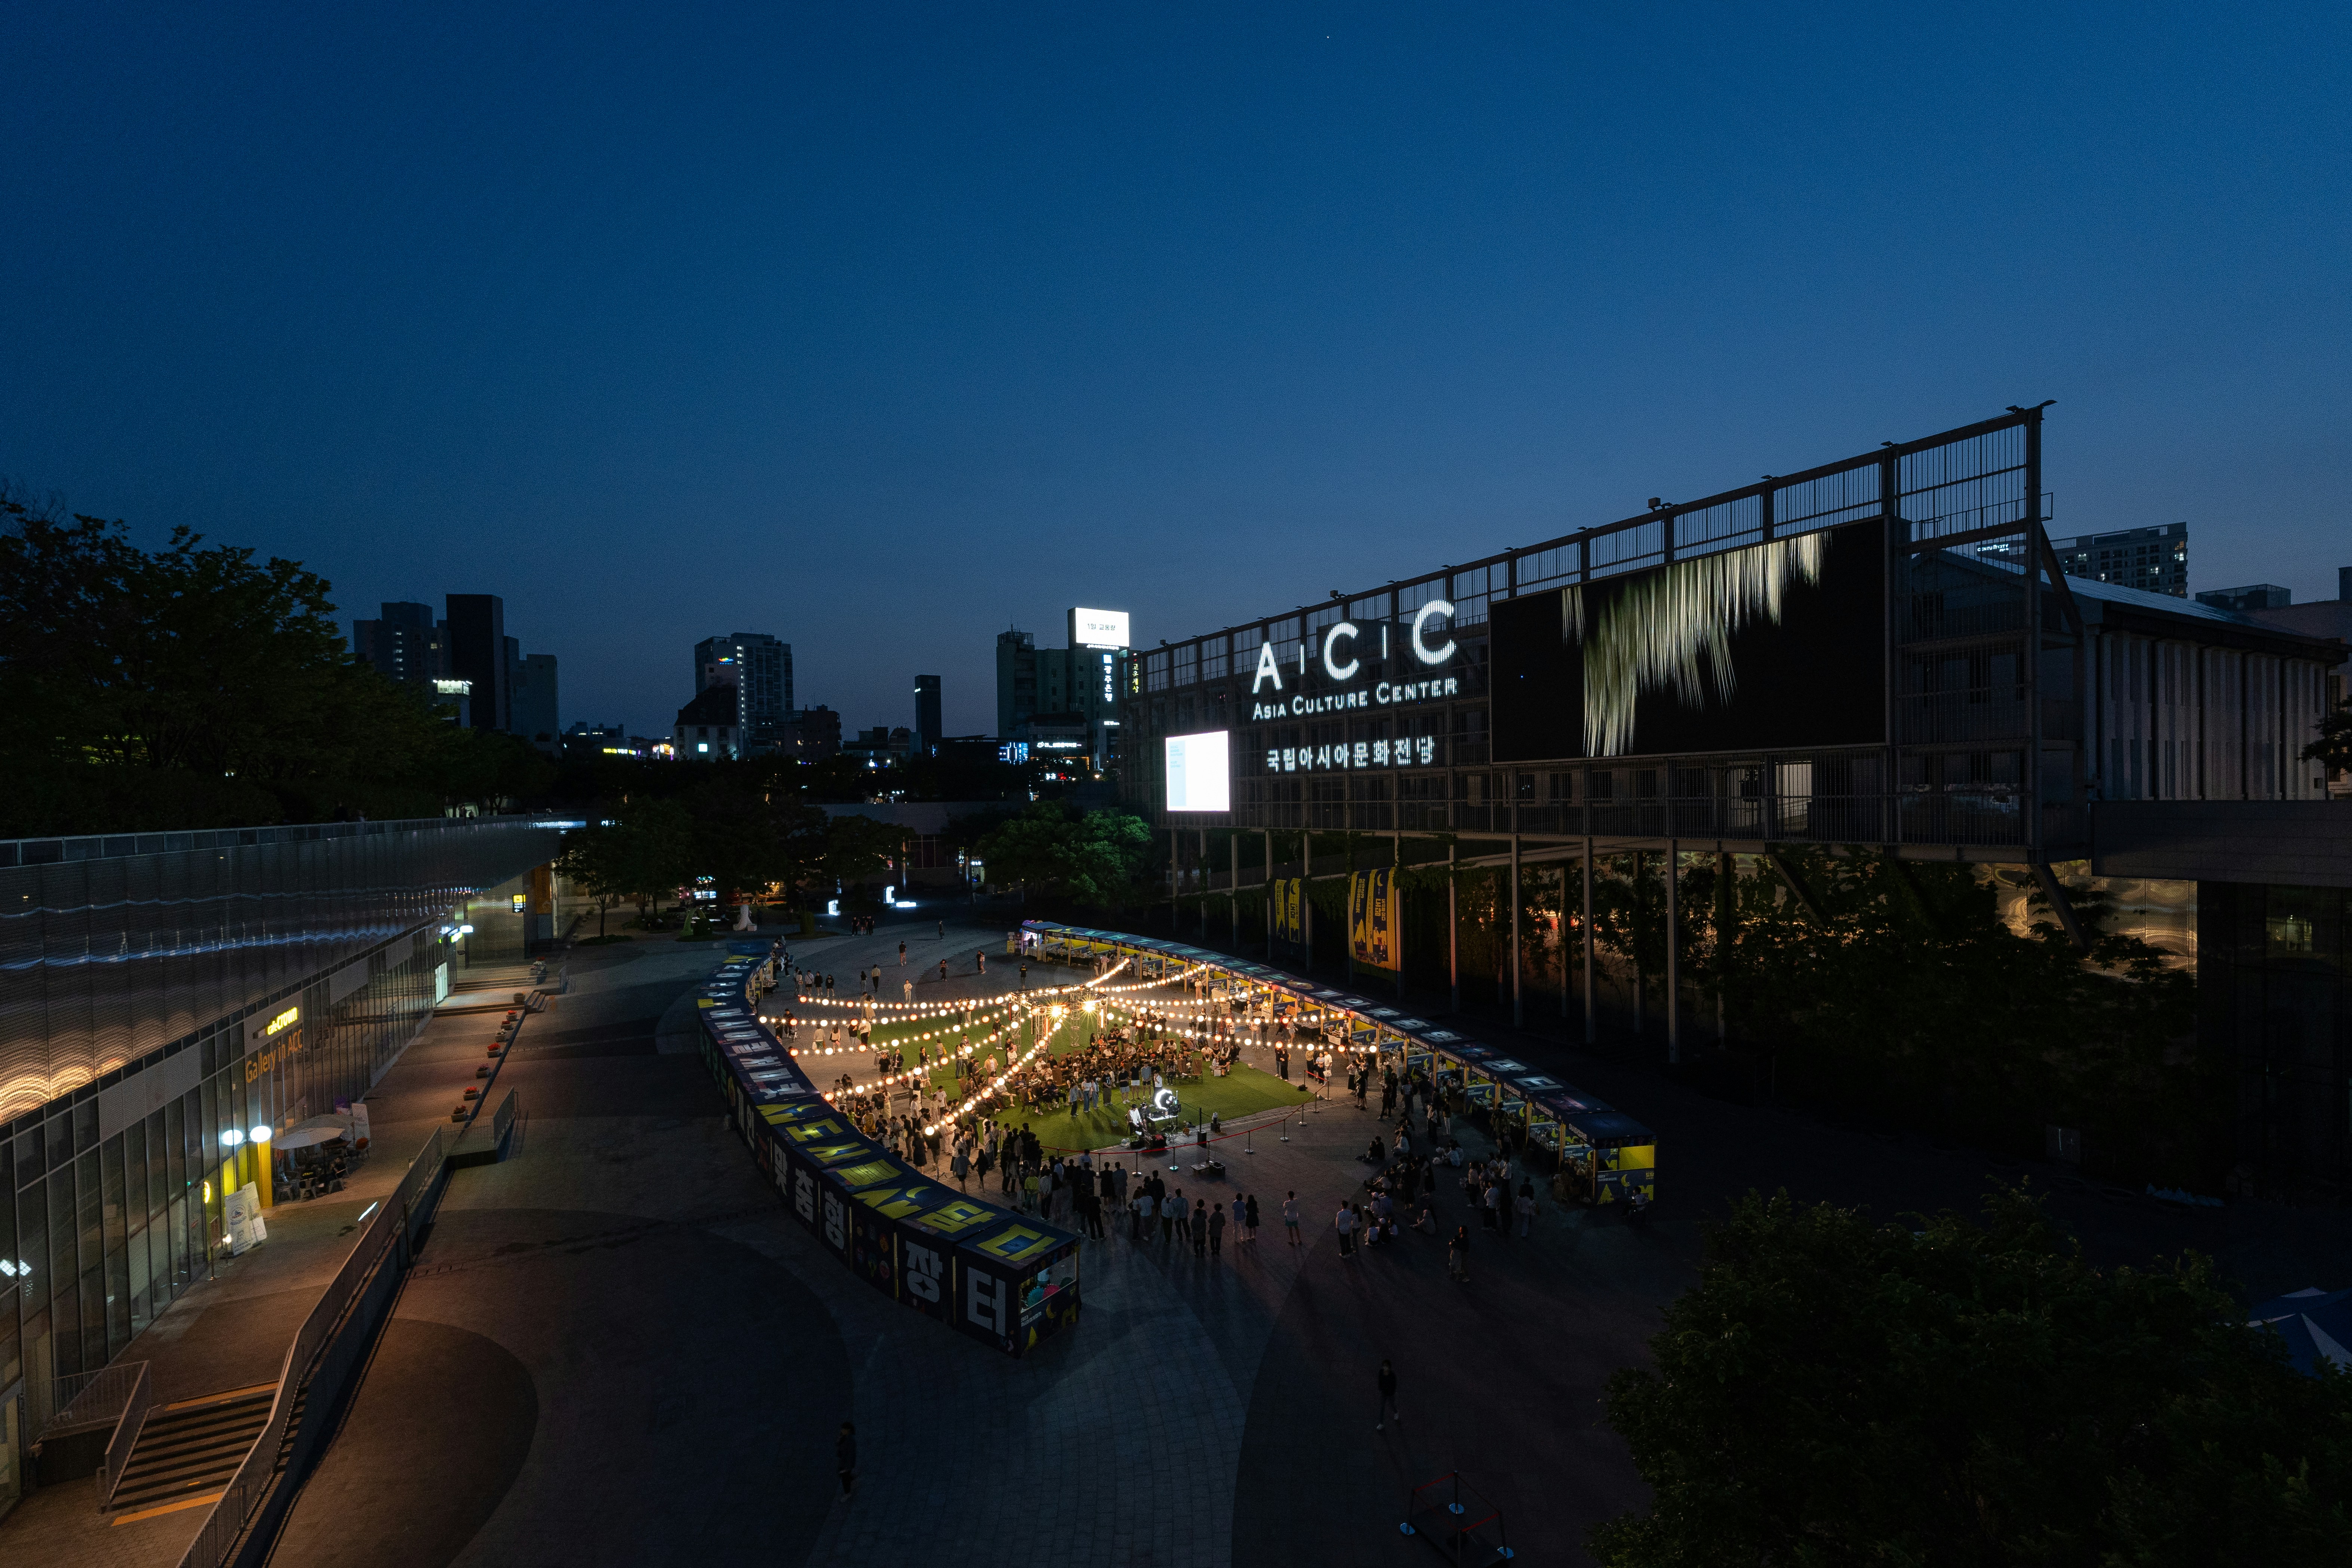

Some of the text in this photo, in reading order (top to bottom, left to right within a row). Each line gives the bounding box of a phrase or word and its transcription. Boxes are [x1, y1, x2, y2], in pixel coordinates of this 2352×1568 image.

[1104, 666, 1112, 702] 광주은행
[1267, 735, 1435, 772] 국립아시아문화전당
[245, 1029, 303, 1083] Gallery in ACC
[785, 1118, 1057, 1262] 도시를 담다
[774, 1142, 1006, 1337] 맞춤형 장터
